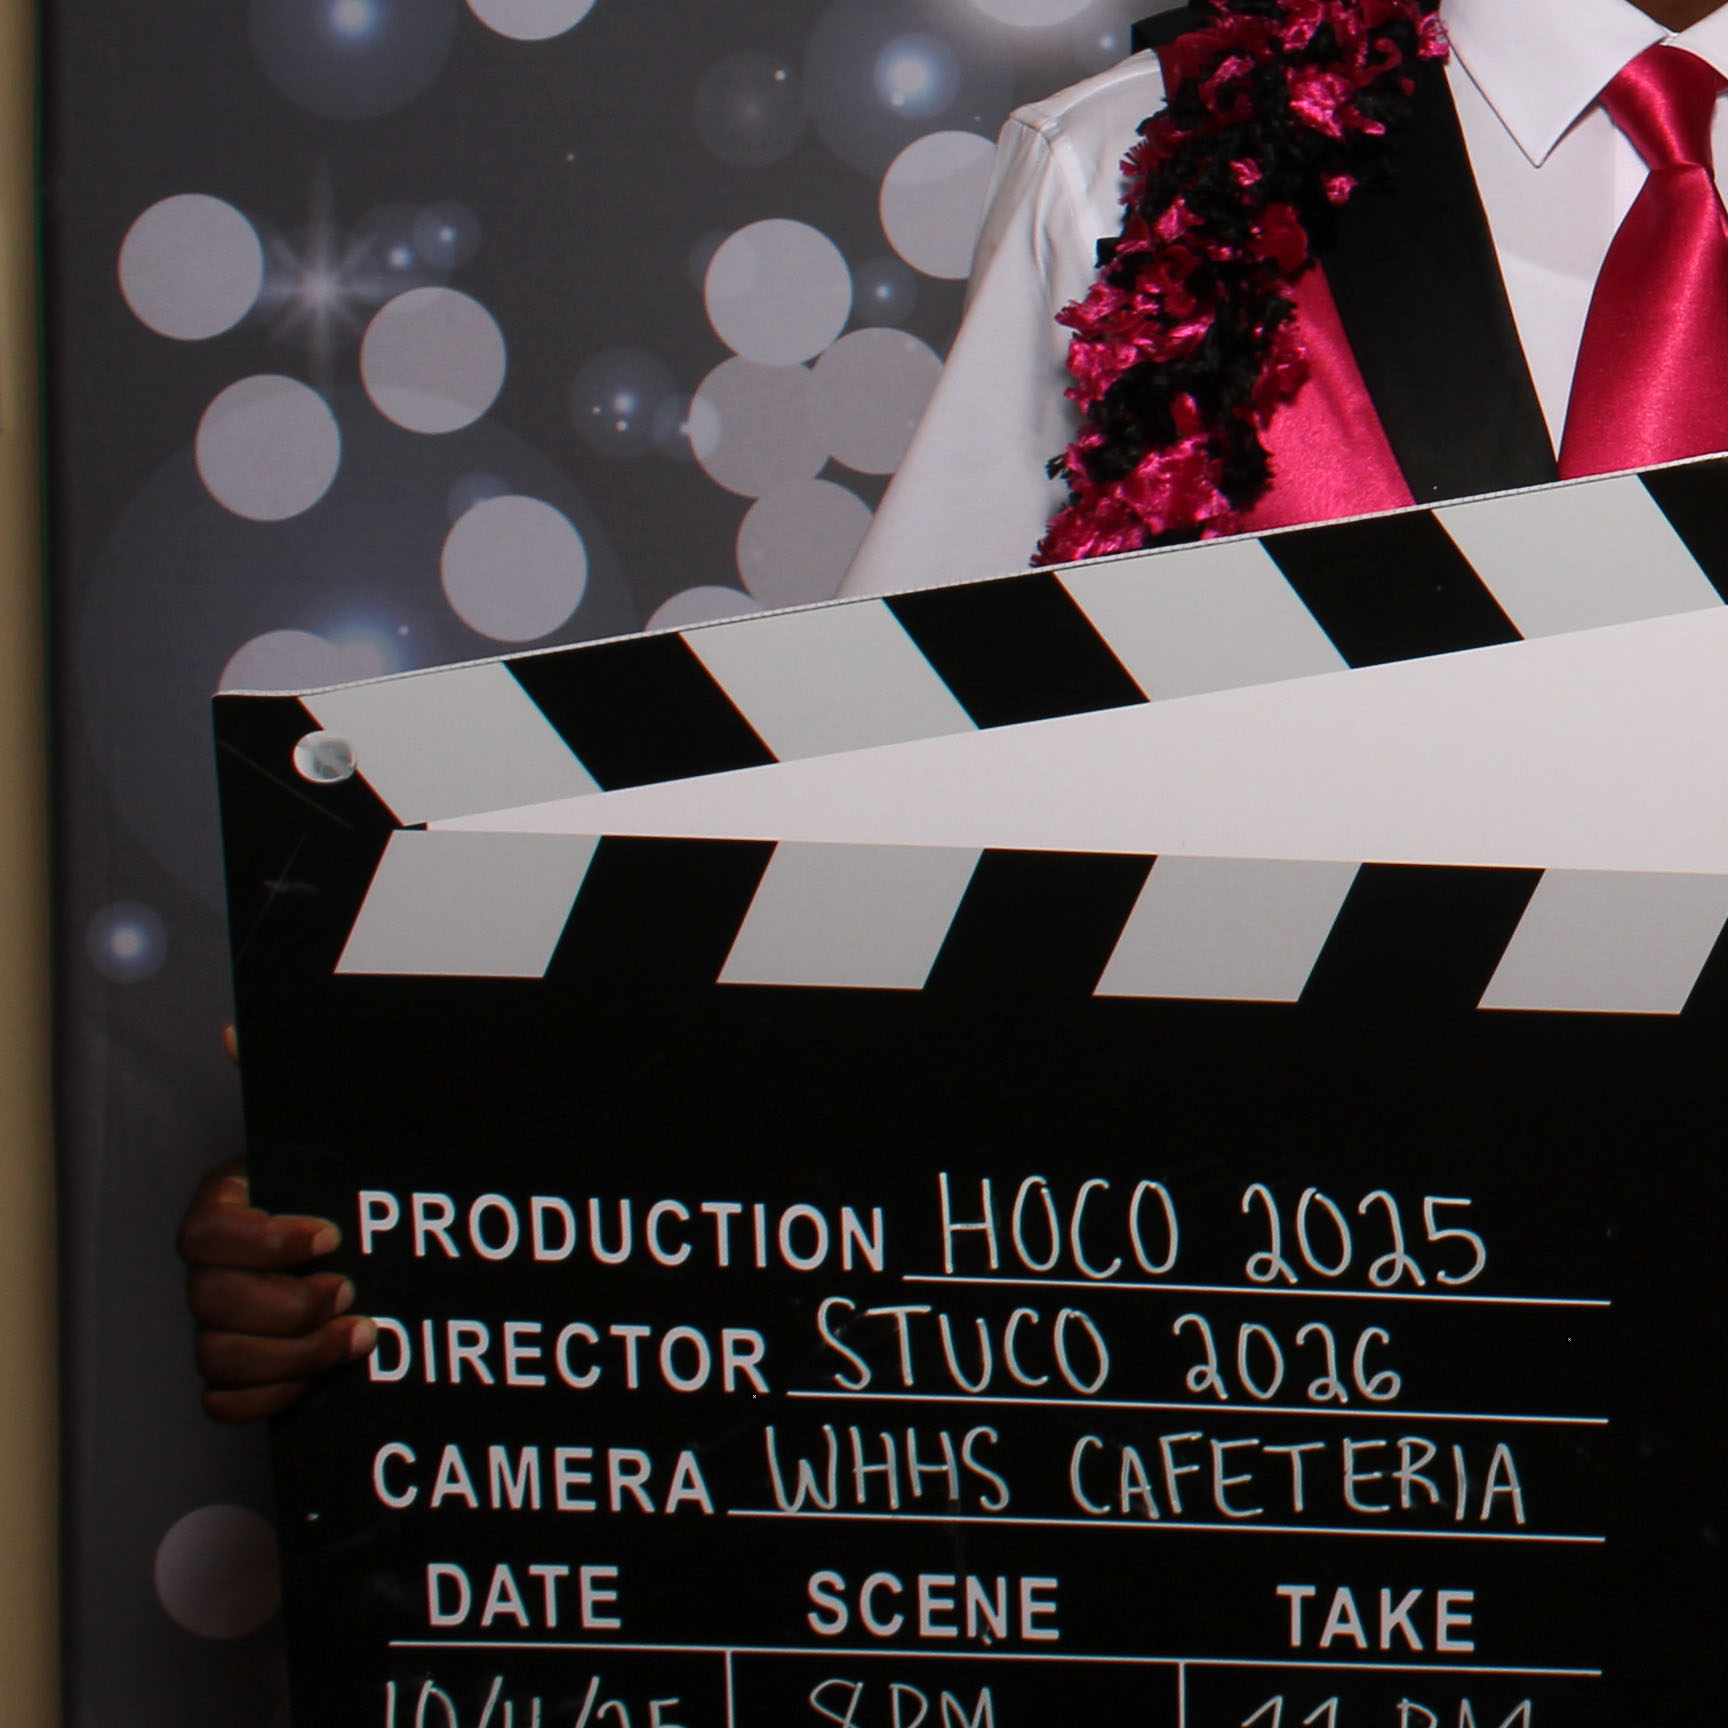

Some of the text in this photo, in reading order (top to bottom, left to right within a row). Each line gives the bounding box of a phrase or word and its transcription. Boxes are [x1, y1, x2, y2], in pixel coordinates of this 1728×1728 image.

[358, 1189, 884, 1271] PRODUCTION
[938, 1172, 1487, 1287] HOCO 2025
[368, 1316, 770, 1394] DIRECTOR
[817, 1297, 1402, 1403] STUCO 2026
[373, 1442, 715, 1514] CAMERA
[765, 1424, 1526, 1525] WHHS CAFETERIA
[427, 1563, 1475, 1653] DATE SCENE TAKE
